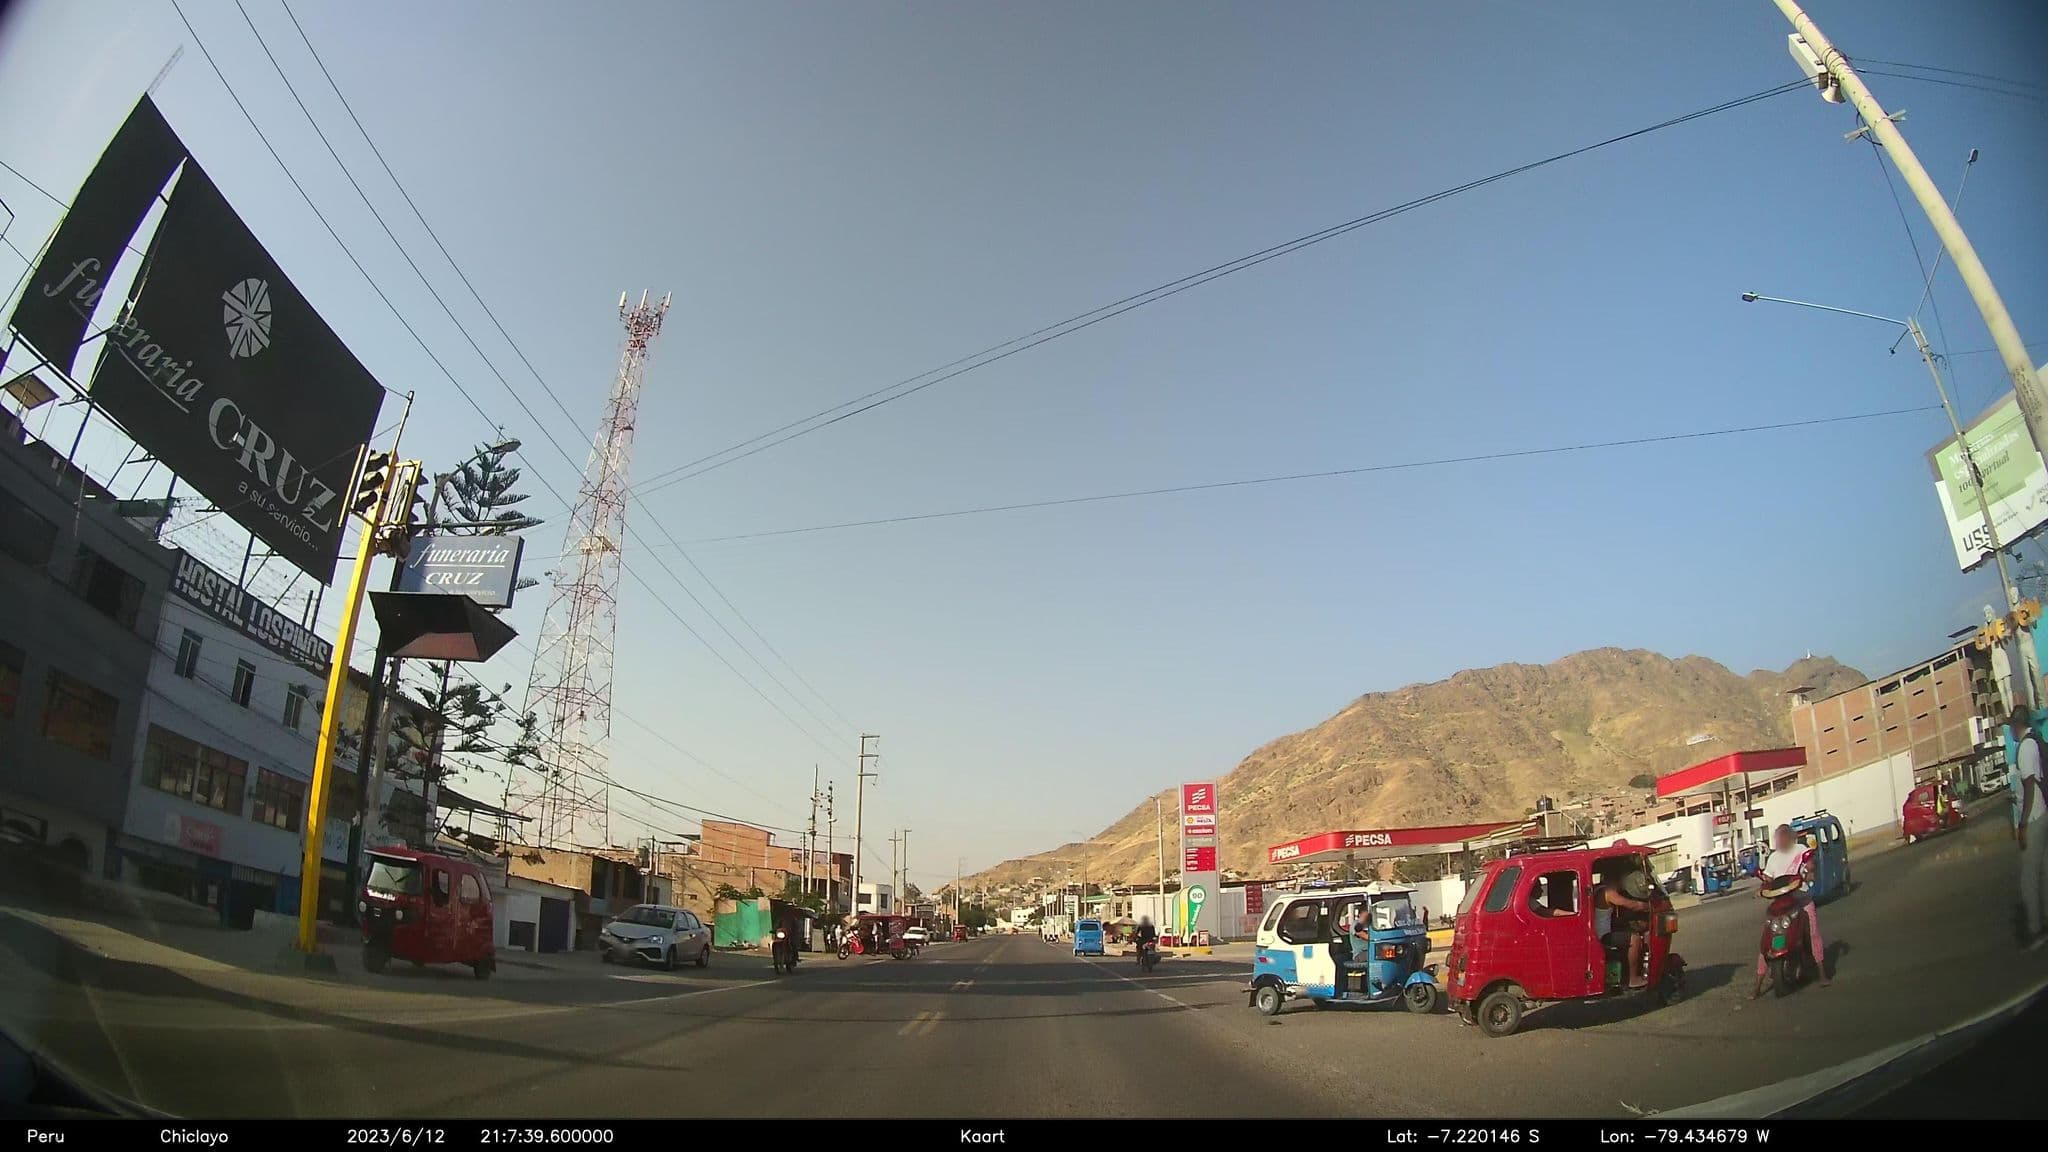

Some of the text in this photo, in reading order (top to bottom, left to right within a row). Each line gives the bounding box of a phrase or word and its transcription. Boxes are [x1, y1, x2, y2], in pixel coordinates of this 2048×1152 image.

[208, 397, 337, 534] CRUZ
[238, 481, 249, 494] a
[409, 543, 510, 569] funeraria
[425, 572, 485, 585] CRUZ
[174, 554, 247, 627] HOSTAL
[1355, 833, 1392, 846] PECSA
[1277, 844, 1300, 860] PECSA
